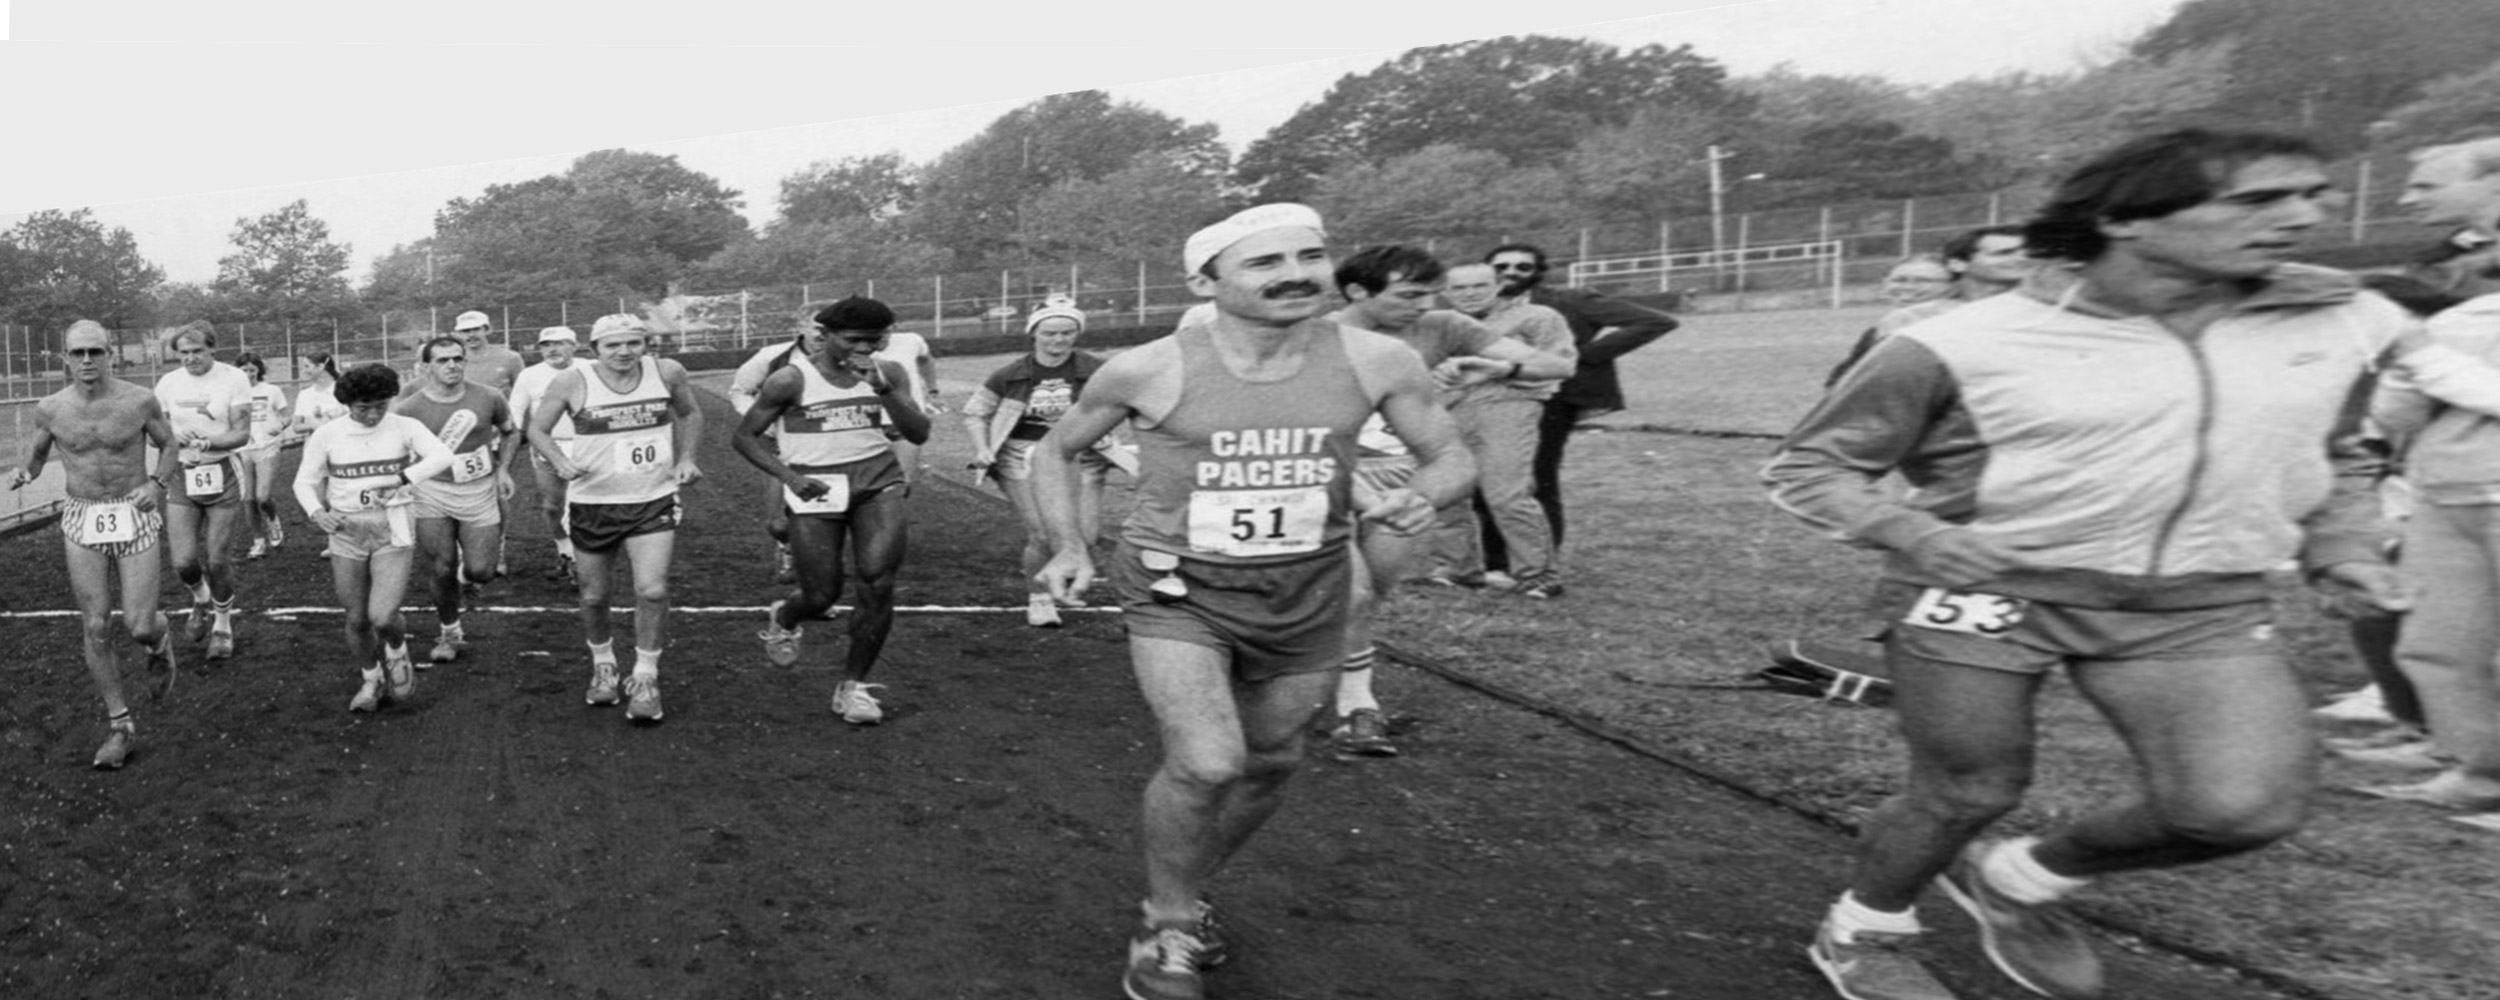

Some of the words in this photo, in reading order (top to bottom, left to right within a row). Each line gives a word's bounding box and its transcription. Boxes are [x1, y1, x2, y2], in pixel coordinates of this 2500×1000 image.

[632, 445, 656, 465] 60
[1211, 427, 1332, 457] CAHIT
[195, 472, 213, 488] 64
[1196, 457, 1337, 488] PACERS
[96, 513, 118, 534] 63
[1230, 506, 1287, 542] 51
[1925, 590, 2022, 635] 53
